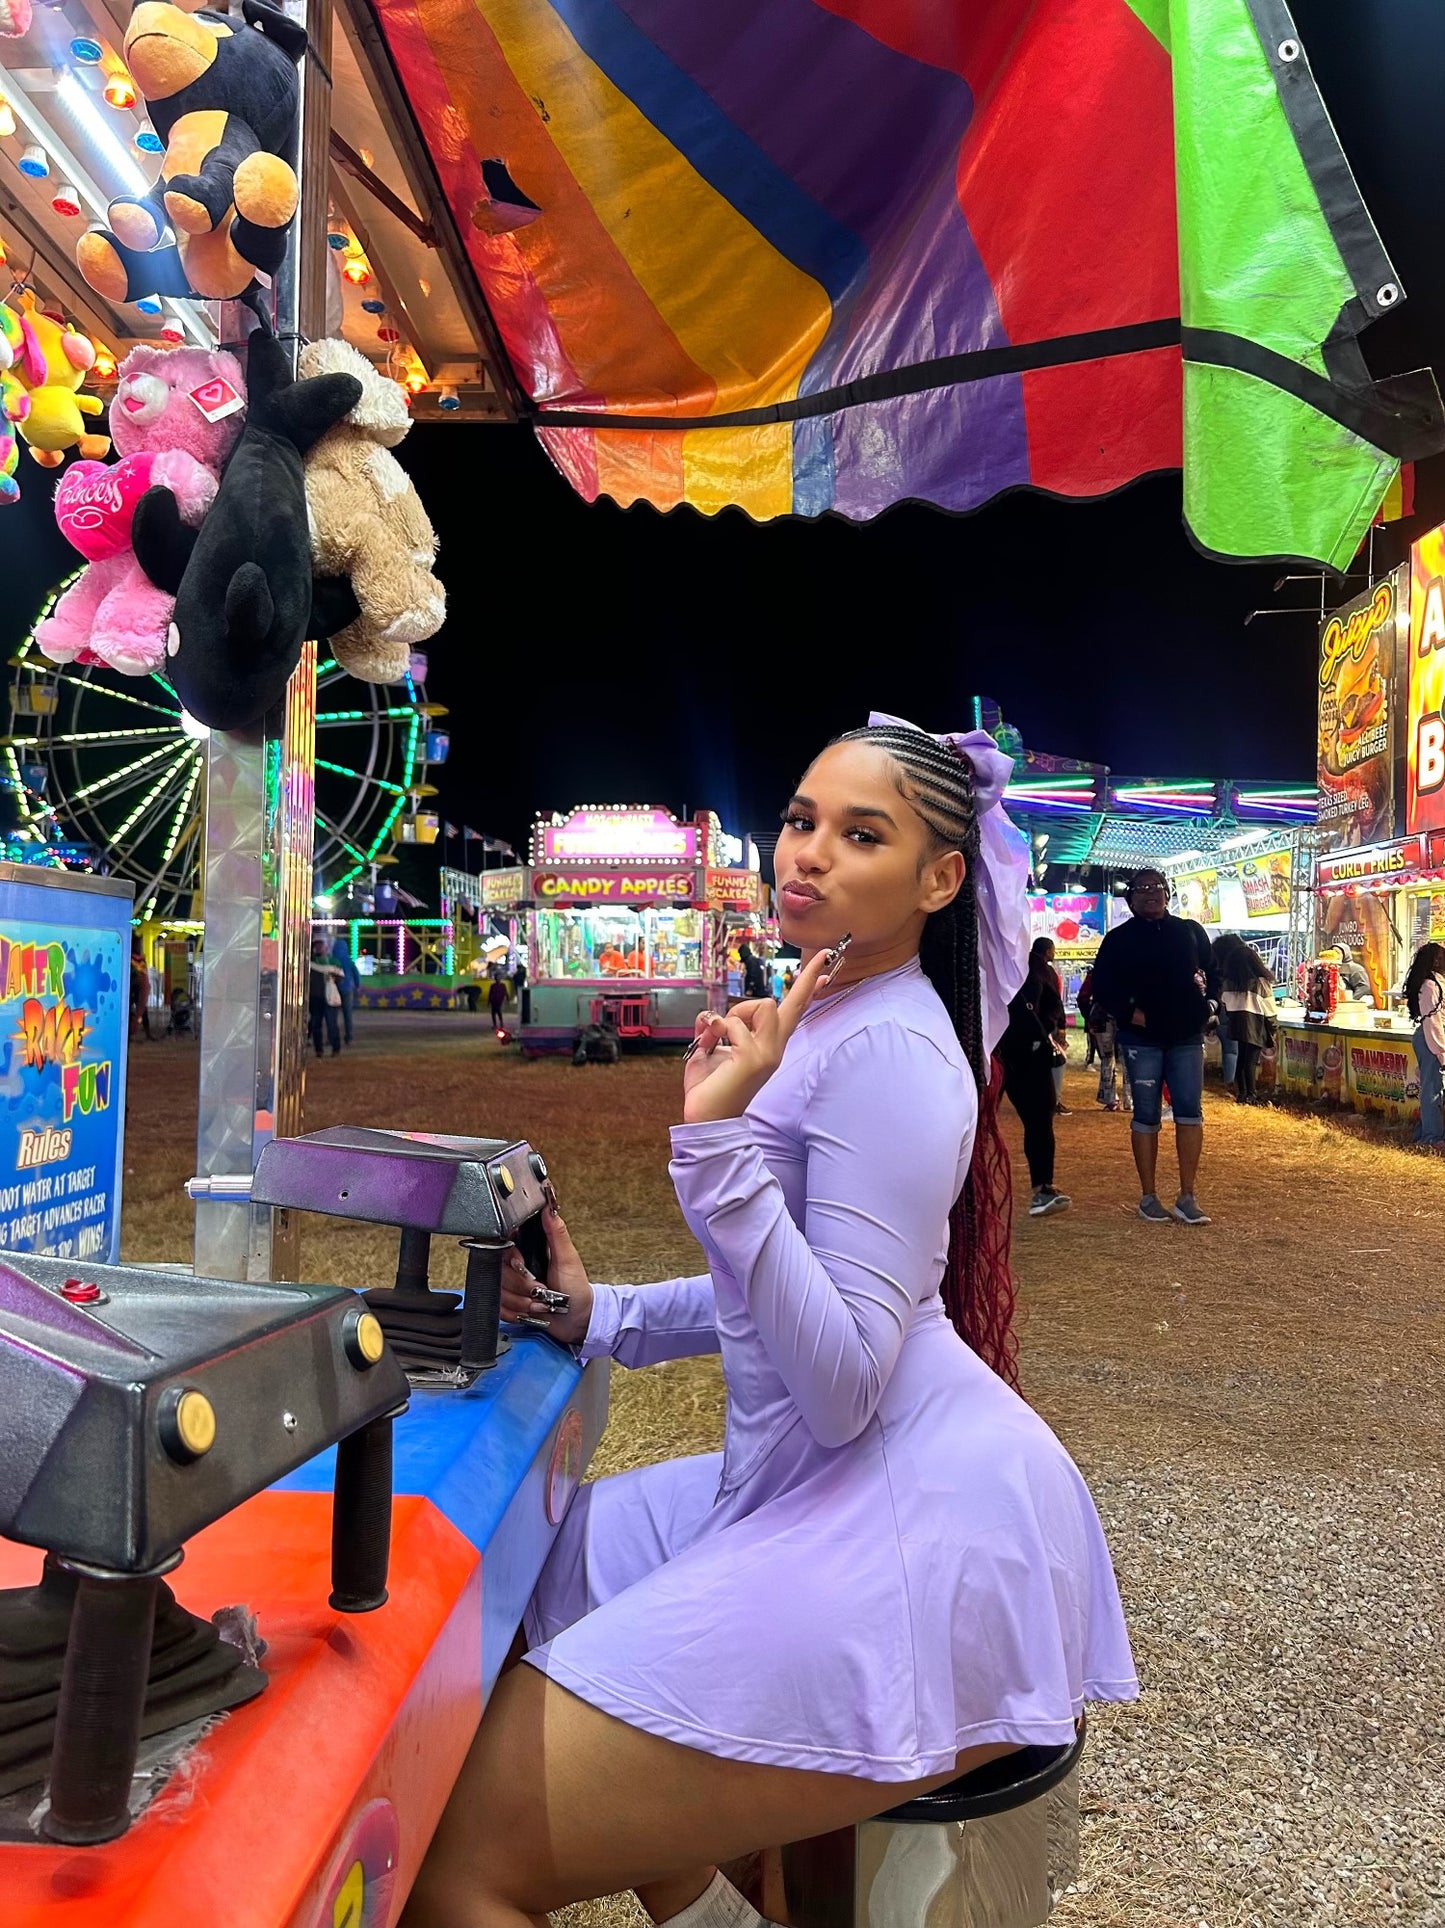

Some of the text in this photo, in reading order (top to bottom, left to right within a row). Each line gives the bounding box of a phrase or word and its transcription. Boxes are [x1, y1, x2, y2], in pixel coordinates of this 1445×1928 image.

[1372, 723, 1388, 741] BEEF
[1343, 738, 1387, 767] JUICY BURGER
[1333, 791, 1347, 805] SIZED
[1339, 800, 1357, 815] TURKEY
[1358, 796, 1370, 810] LEG
[1331, 848, 1405, 880] CURLY FRIES
[541, 877, 689, 896] CANDY APPLES
[712, 876, 750, 888] FUNNEL
[1242, 875, 1269, 895] SMASH
[714, 888, 750, 900] CAKES
[1245, 894, 1272, 910] BURGER
[1053, 895, 1098, 913] CANDY
[1349, 933, 1365, 946] DOGS
[23, 998, 85, 1075] RACE
[62, 1061, 111, 1122] FUN
[17, 1126, 72, 1168] Rules
[23, 1177, 52, 1207] WATER
[54, 1173, 66, 1197] AT
[67, 1165, 96, 1194] TARGET
[10, 1211, 42, 1242] TARGET
[43, 1200, 83, 1231] ADVANCES
[83, 1192, 106, 1219] RACER
